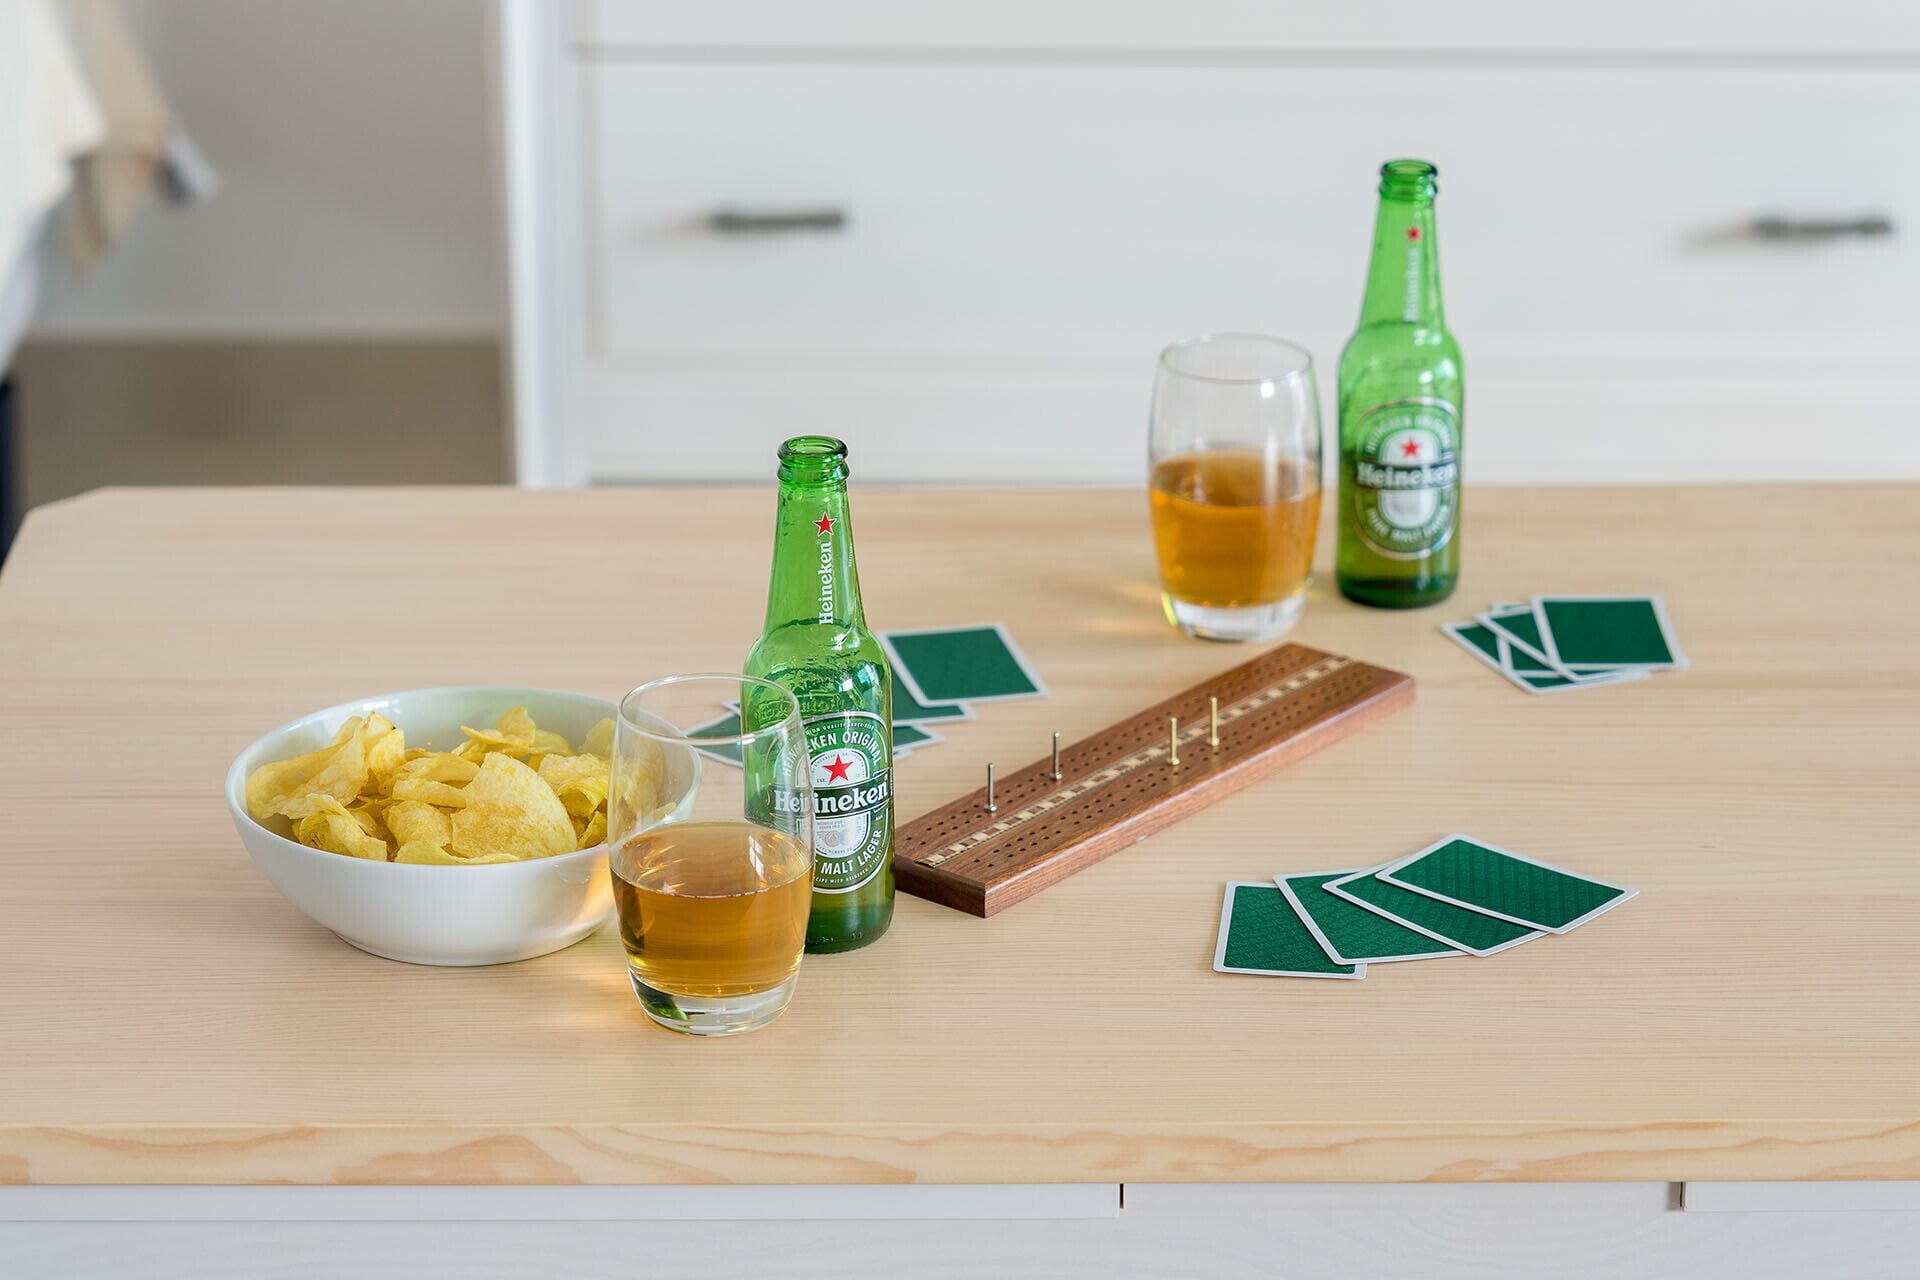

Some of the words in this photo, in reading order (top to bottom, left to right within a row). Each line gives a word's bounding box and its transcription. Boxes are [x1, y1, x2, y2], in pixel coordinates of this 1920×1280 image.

[1356, 462, 1457, 488] Heineken
[817, 540, 834, 625] Heineken
[842, 731, 882, 766] ORIGINAL
[773, 783, 888, 813] Heineken
[820, 859, 855, 875] MALT
[857, 830, 882, 866] LAGER
